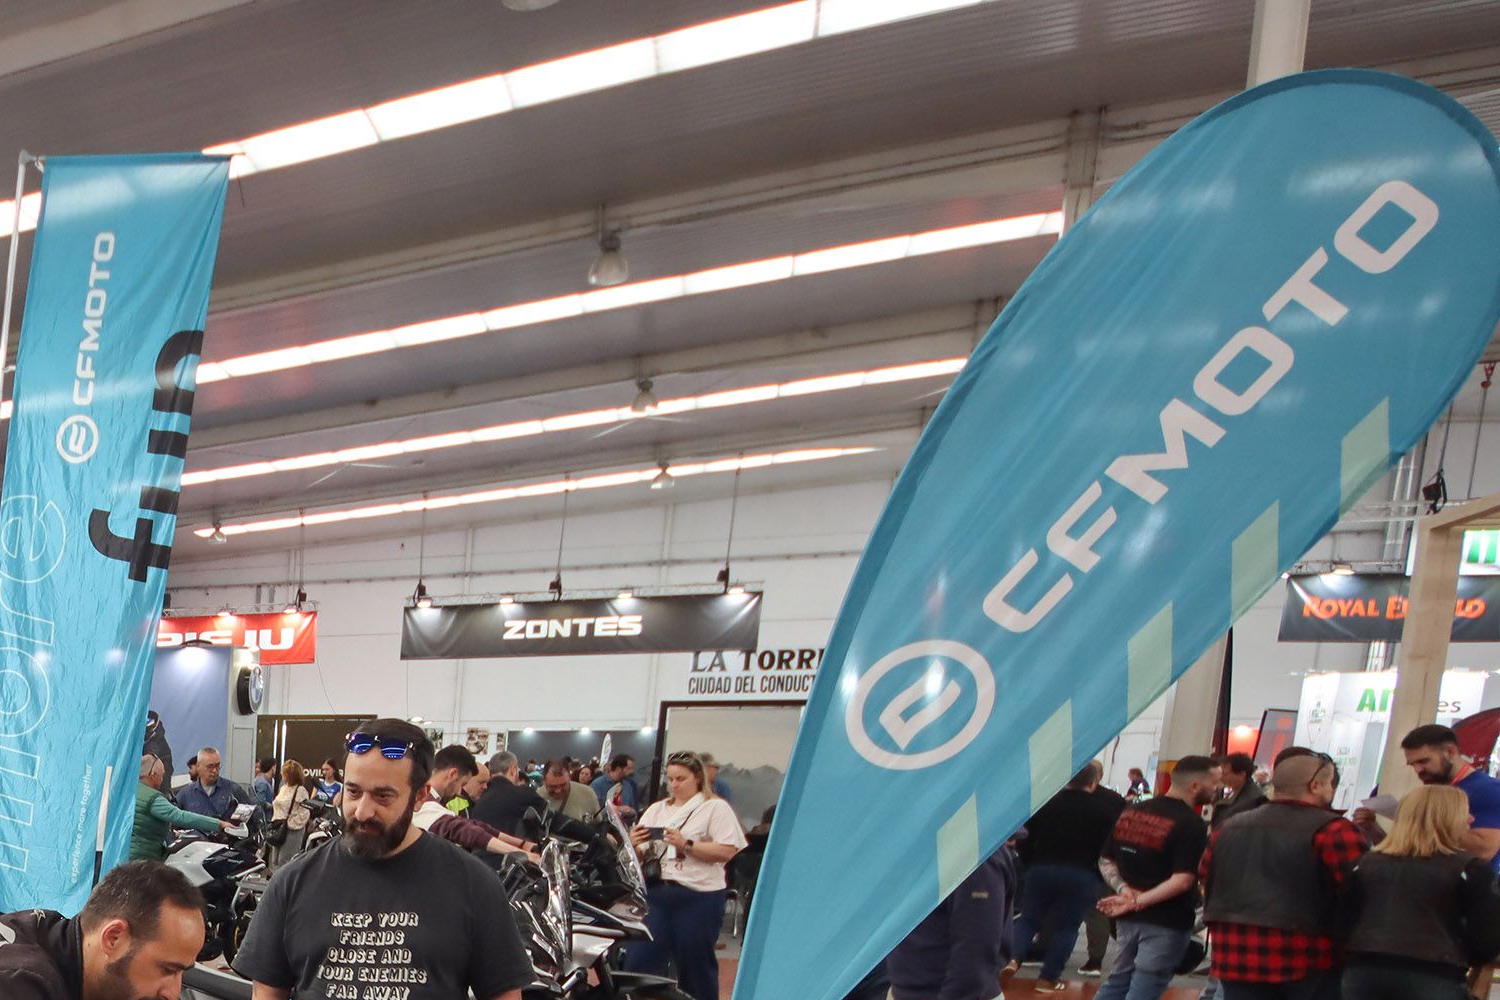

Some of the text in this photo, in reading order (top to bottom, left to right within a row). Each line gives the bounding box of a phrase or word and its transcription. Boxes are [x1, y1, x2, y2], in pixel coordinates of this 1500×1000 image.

[72, 231, 116, 406] CFMOTO
[982, 180, 1439, 634] CFMOTO
[1303, 595, 1380, 620] ROYAL
[503, 615, 642, 640] ZONTES
[690, 650, 727, 673] LA
[688, 676, 732, 695] CIUDAD
[734, 676, 756, 694] DEL
[70, 834, 83, 884] experience
[81, 764, 93, 804] together
[331, 912, 420, 928] KEEP YOUR
[339, 930, 405, 946] FRIENDS
[327, 947, 413, 964] CLOSE AND
[357, 966, 428, 984] ENEMIES
[325, 983, 411, 1000] FAR AWAY
